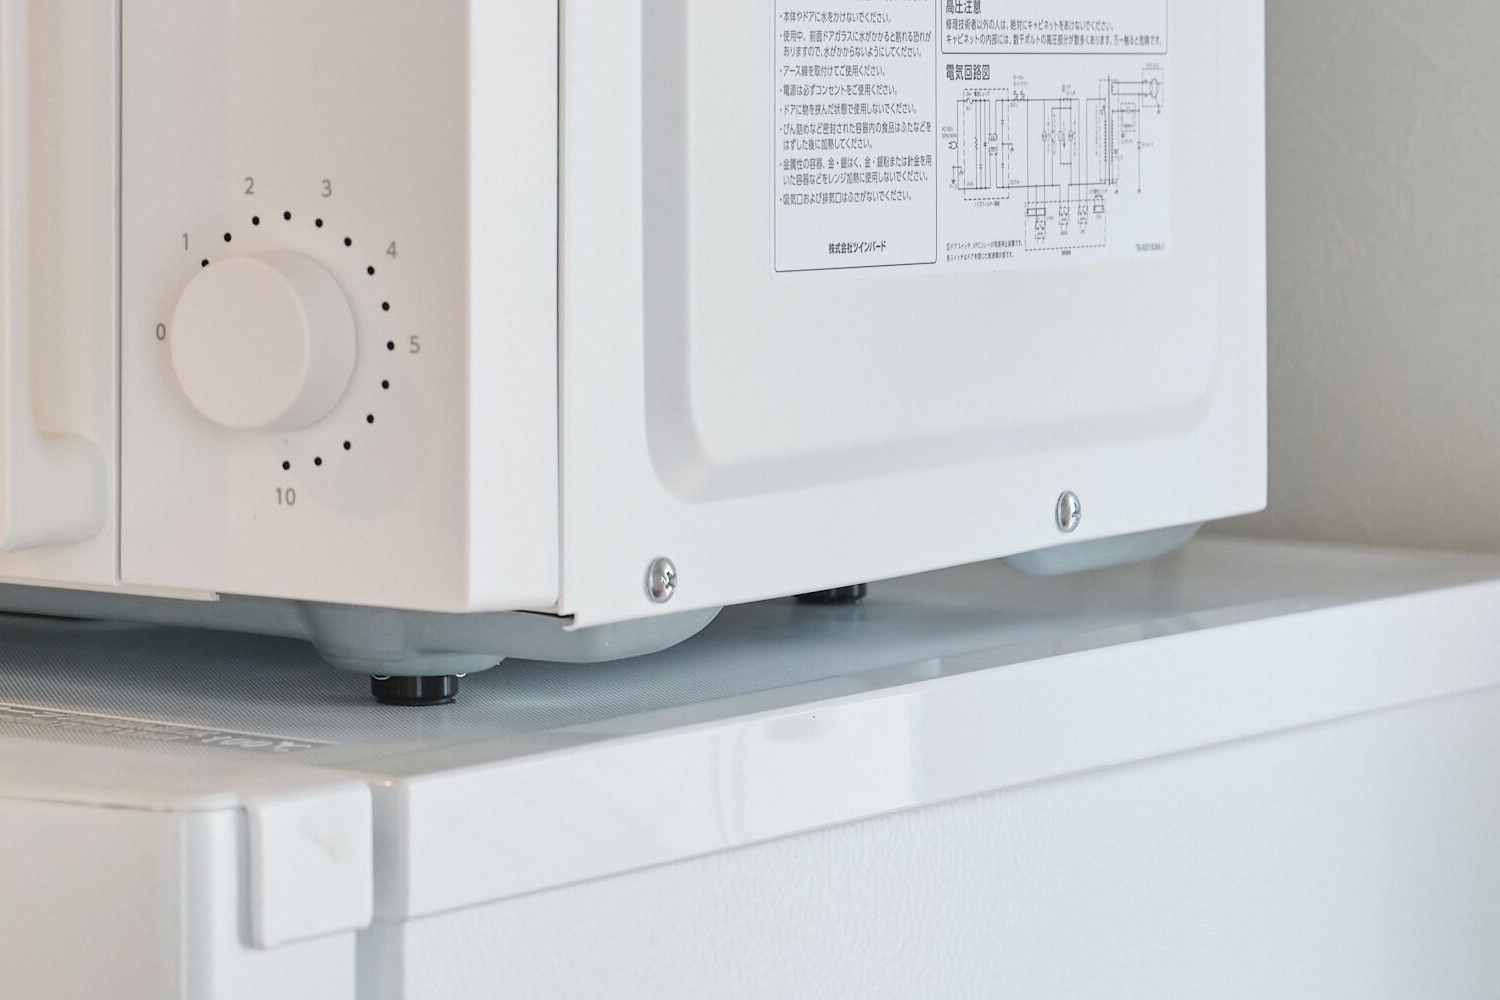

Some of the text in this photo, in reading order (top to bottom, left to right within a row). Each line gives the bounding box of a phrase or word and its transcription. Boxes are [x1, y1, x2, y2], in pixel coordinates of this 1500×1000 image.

[945, 63, 991, 81] 電気回路図
[244, 176, 255, 195] 2
[321, 179, 332, 198] 3
[182, 233, 190, 251] 1
[386, 240, 397, 259] 4
[828, 240, 887, 255] 株式会社ツインバード
[155, 322, 166, 341] 0
[409, 335, 421, 355] 5
[275, 487, 296, 506] 10
